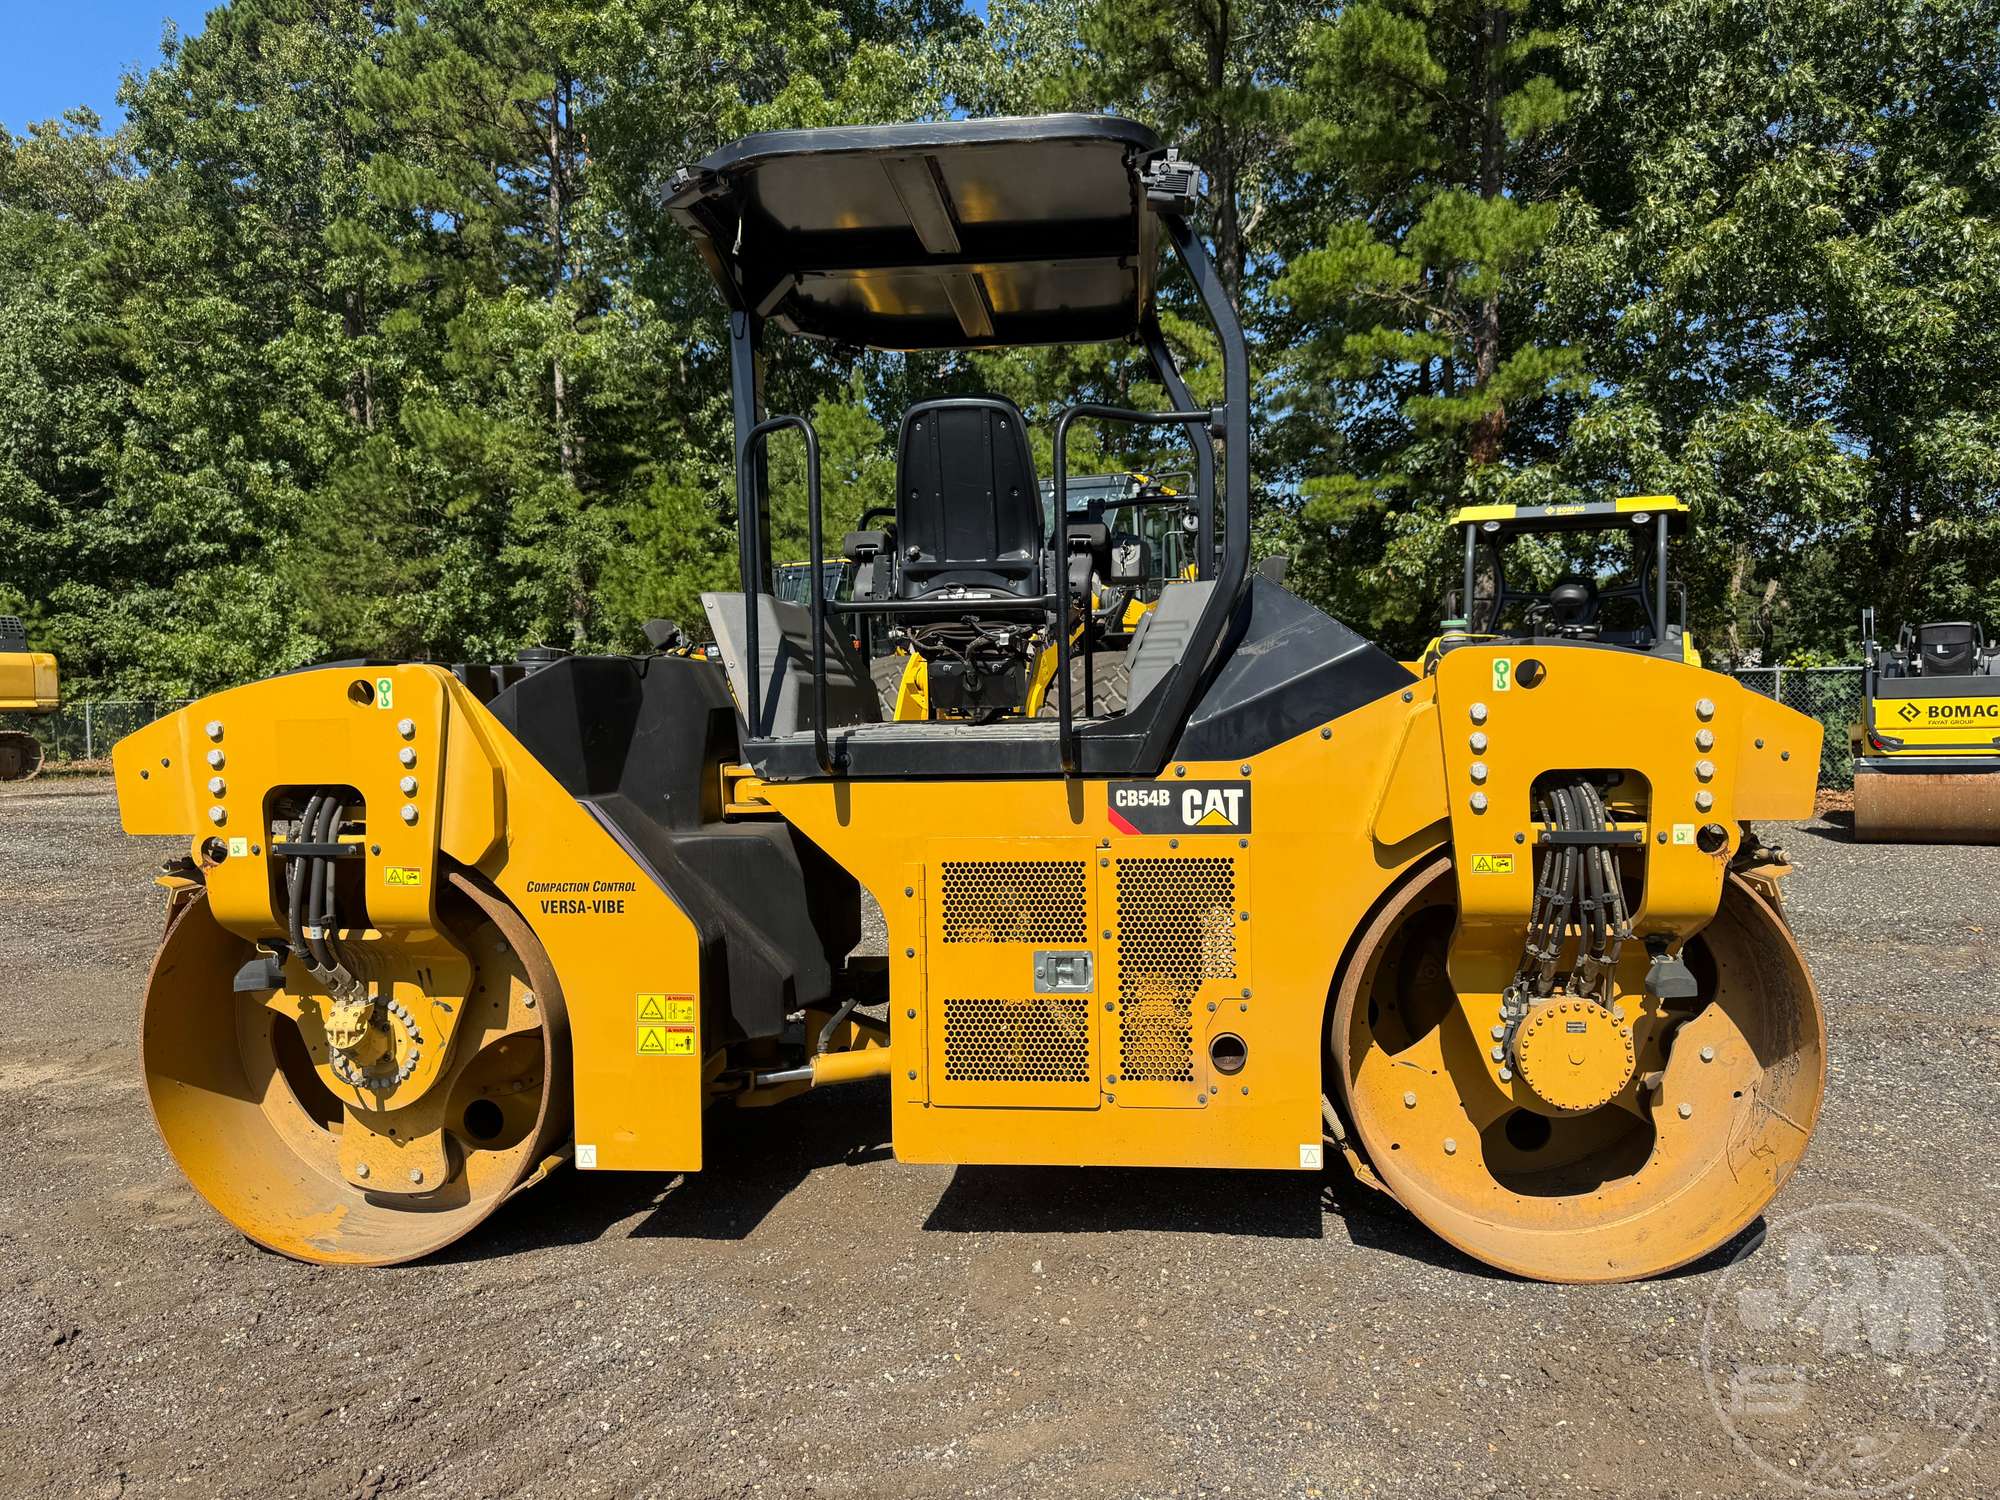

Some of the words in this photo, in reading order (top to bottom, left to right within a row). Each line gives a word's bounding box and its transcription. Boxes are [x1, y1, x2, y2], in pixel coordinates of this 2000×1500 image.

[1928, 704, 1999, 719] BOMAG
[1115, 789, 1170, 807] CB54B
[1181, 788, 1244, 826] CAT
[540, 899, 625, 914] VERSA-VIBE
